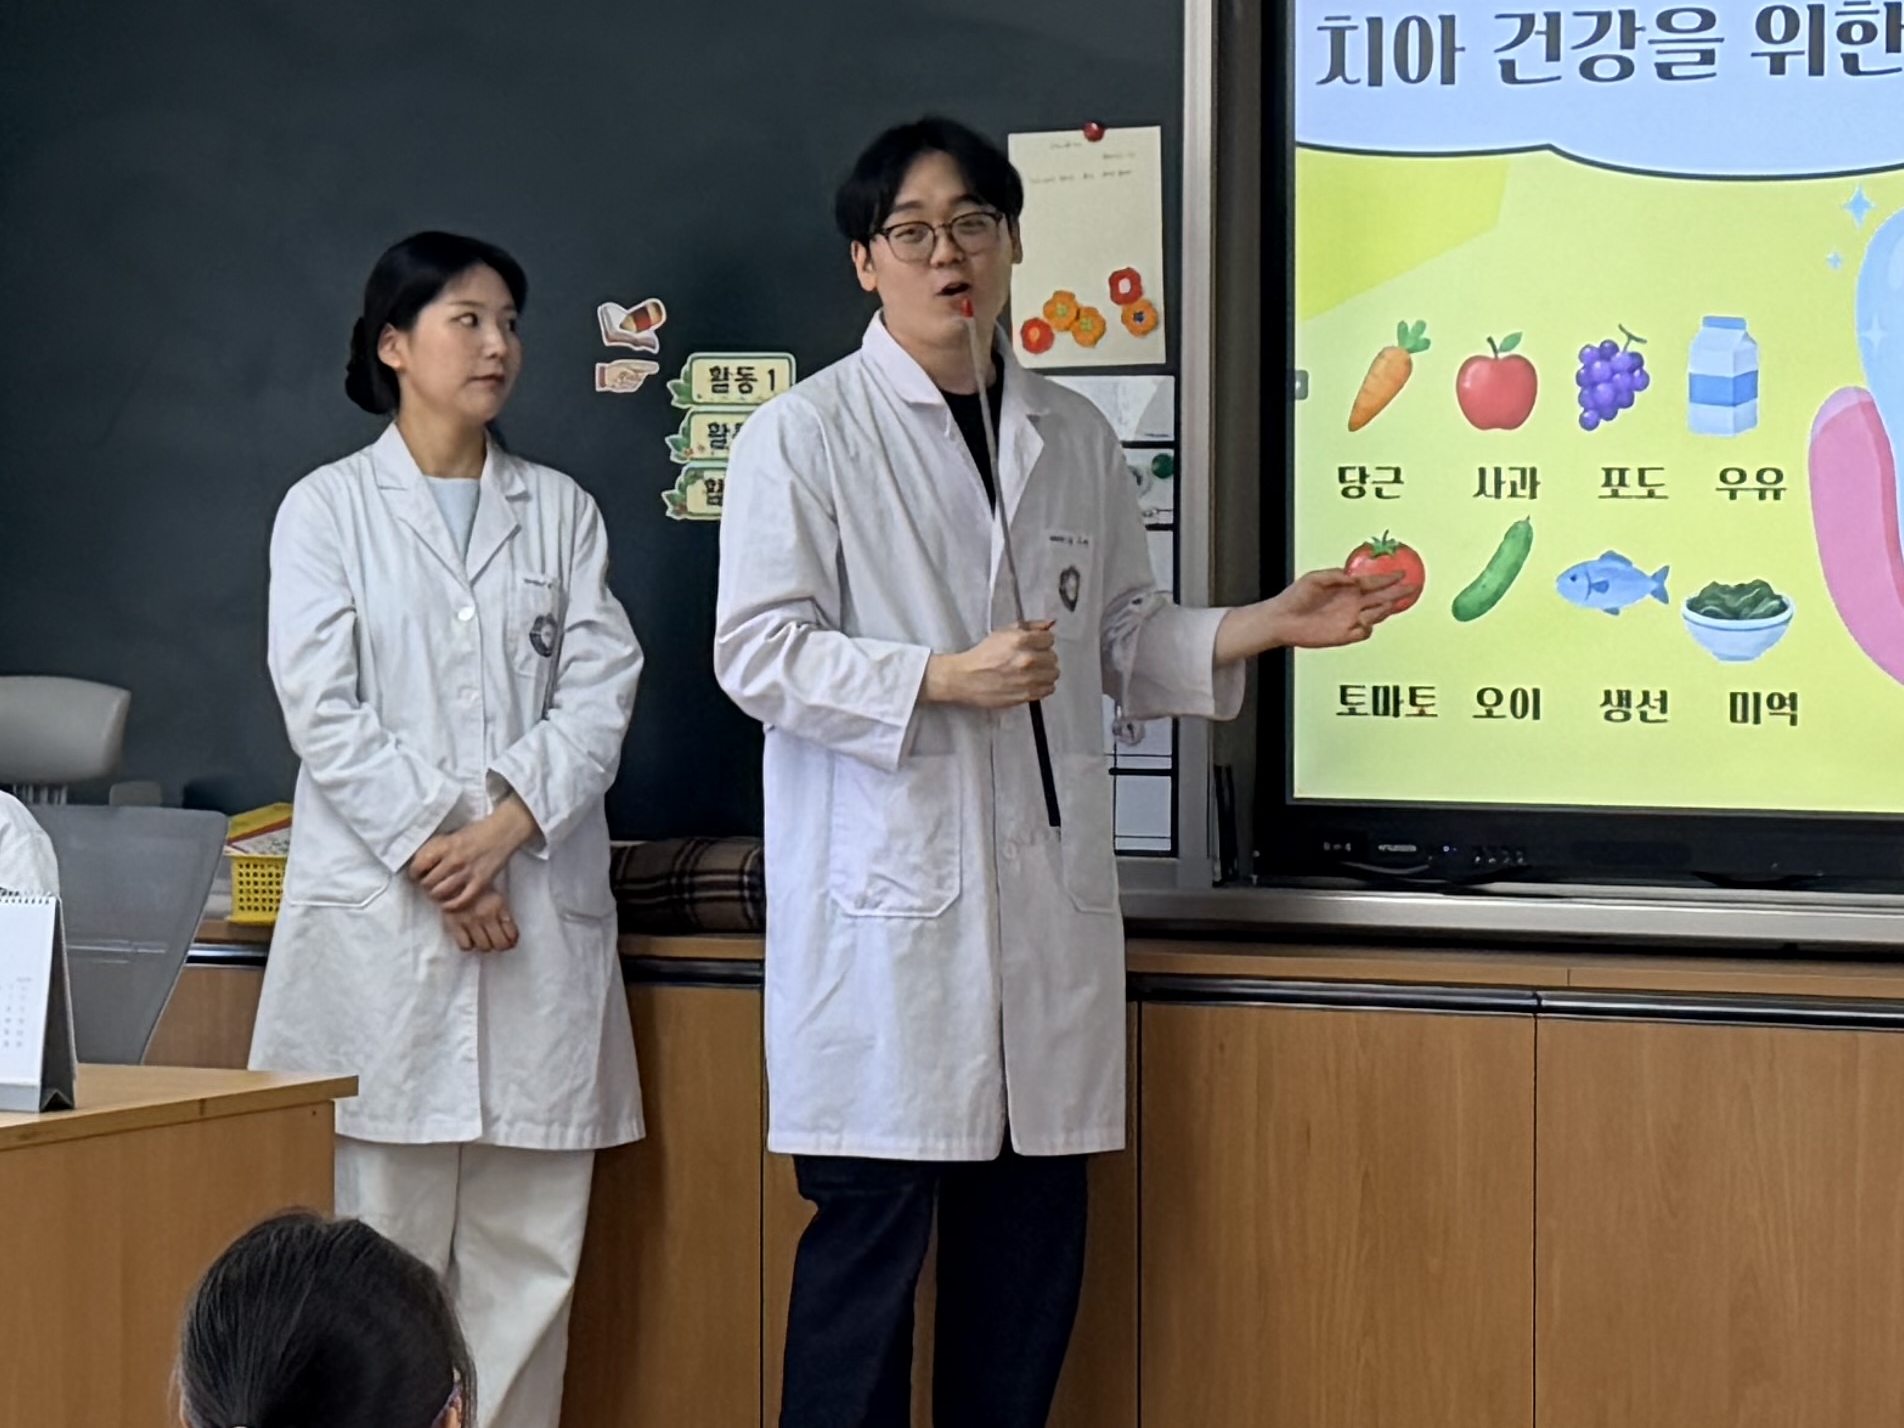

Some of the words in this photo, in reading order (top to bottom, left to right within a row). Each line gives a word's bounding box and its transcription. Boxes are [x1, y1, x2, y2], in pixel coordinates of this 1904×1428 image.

[1314, 13, 1467, 89] 치아
[1492, 6, 1726, 86] 건강을
[766, 368, 776, 393] 1
[1336, 464, 1406, 501] 당근
[1471, 465, 1542, 501] 사과
[1597, 465, 1670, 501] 포도
[1714, 466, 1788, 502] 우유
[1334, 683, 1439, 720] 토마토
[1471, 685, 1542, 722] 오이
[1598, 688, 1669, 725] 생선
[1728, 690, 1799, 728] 미역
